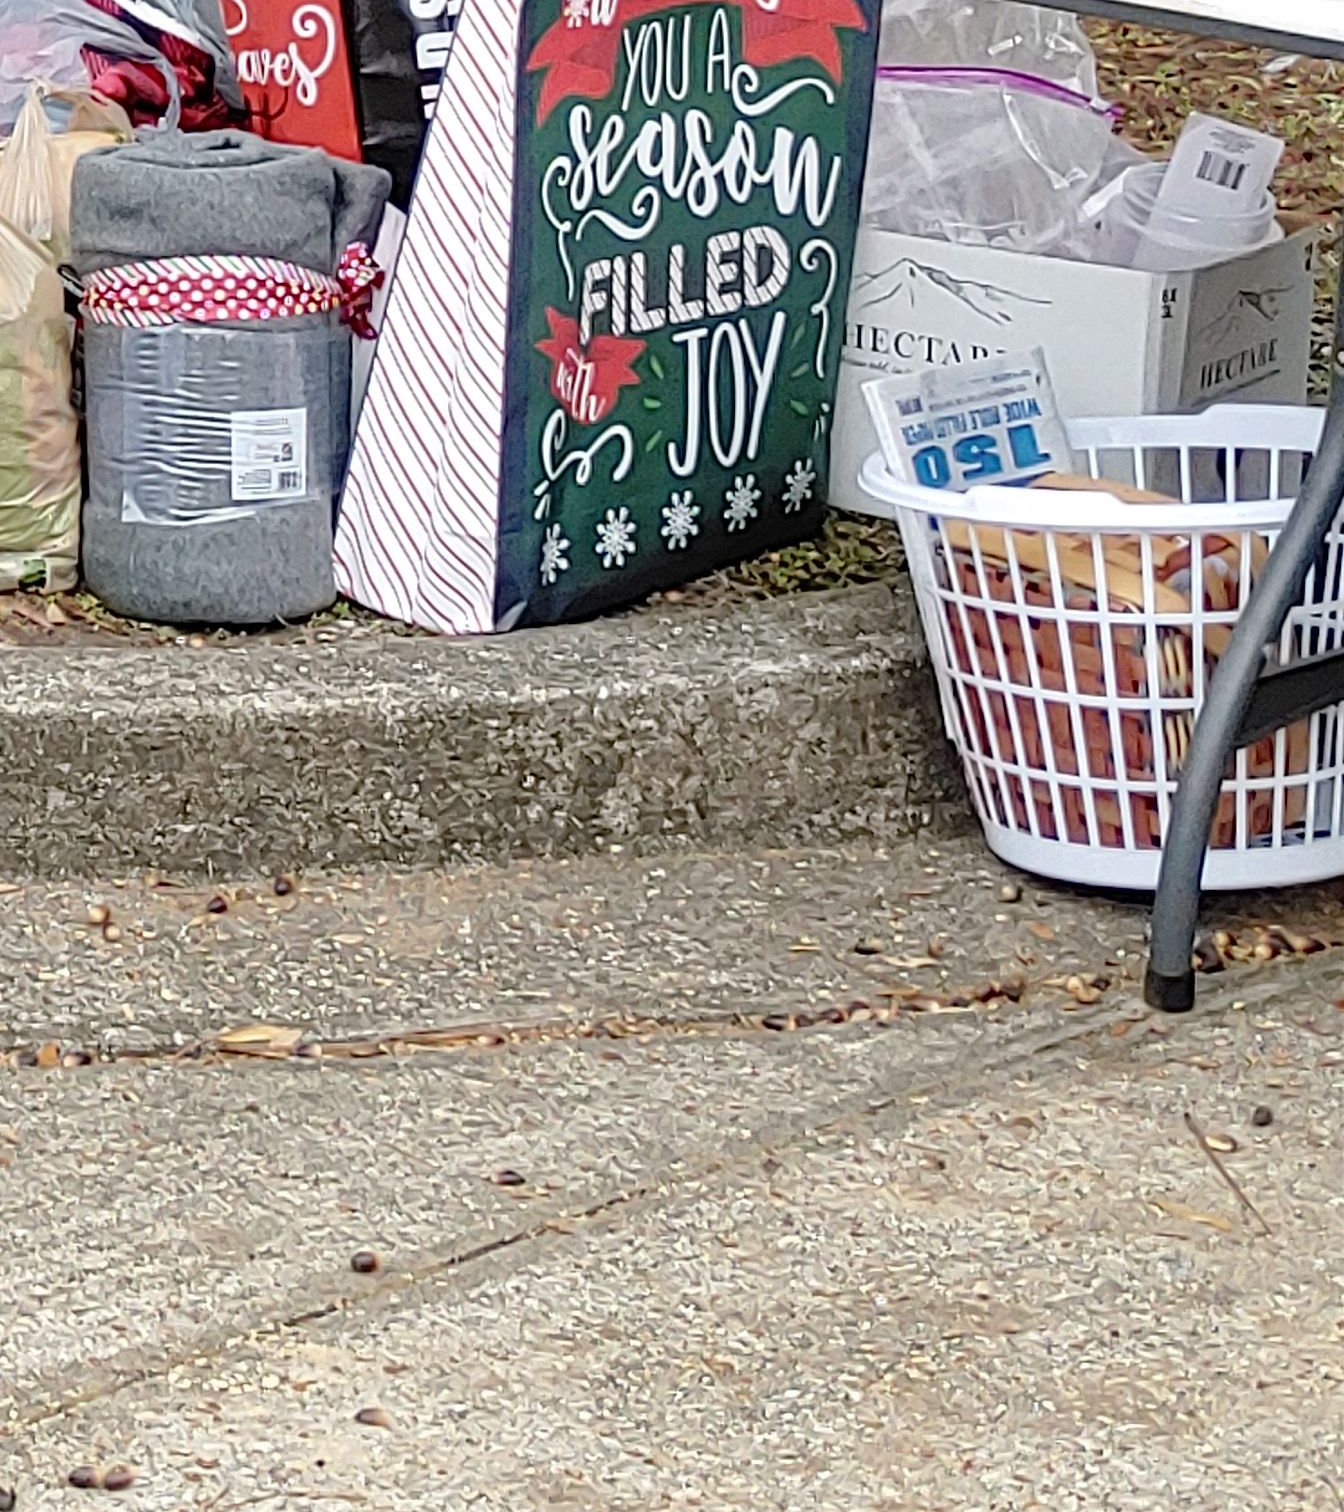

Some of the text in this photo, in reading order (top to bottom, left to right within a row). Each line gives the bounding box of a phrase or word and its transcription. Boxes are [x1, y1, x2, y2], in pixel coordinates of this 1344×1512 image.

[622, 8, 730, 111] YOU A
[569, 104, 841, 227] season
[578, 225, 792, 346] FILLED
[667, 311, 787, 476] JOY
[1200, 339, 1278, 390] HECTARE
[912, 424, 1052, 488] 150
